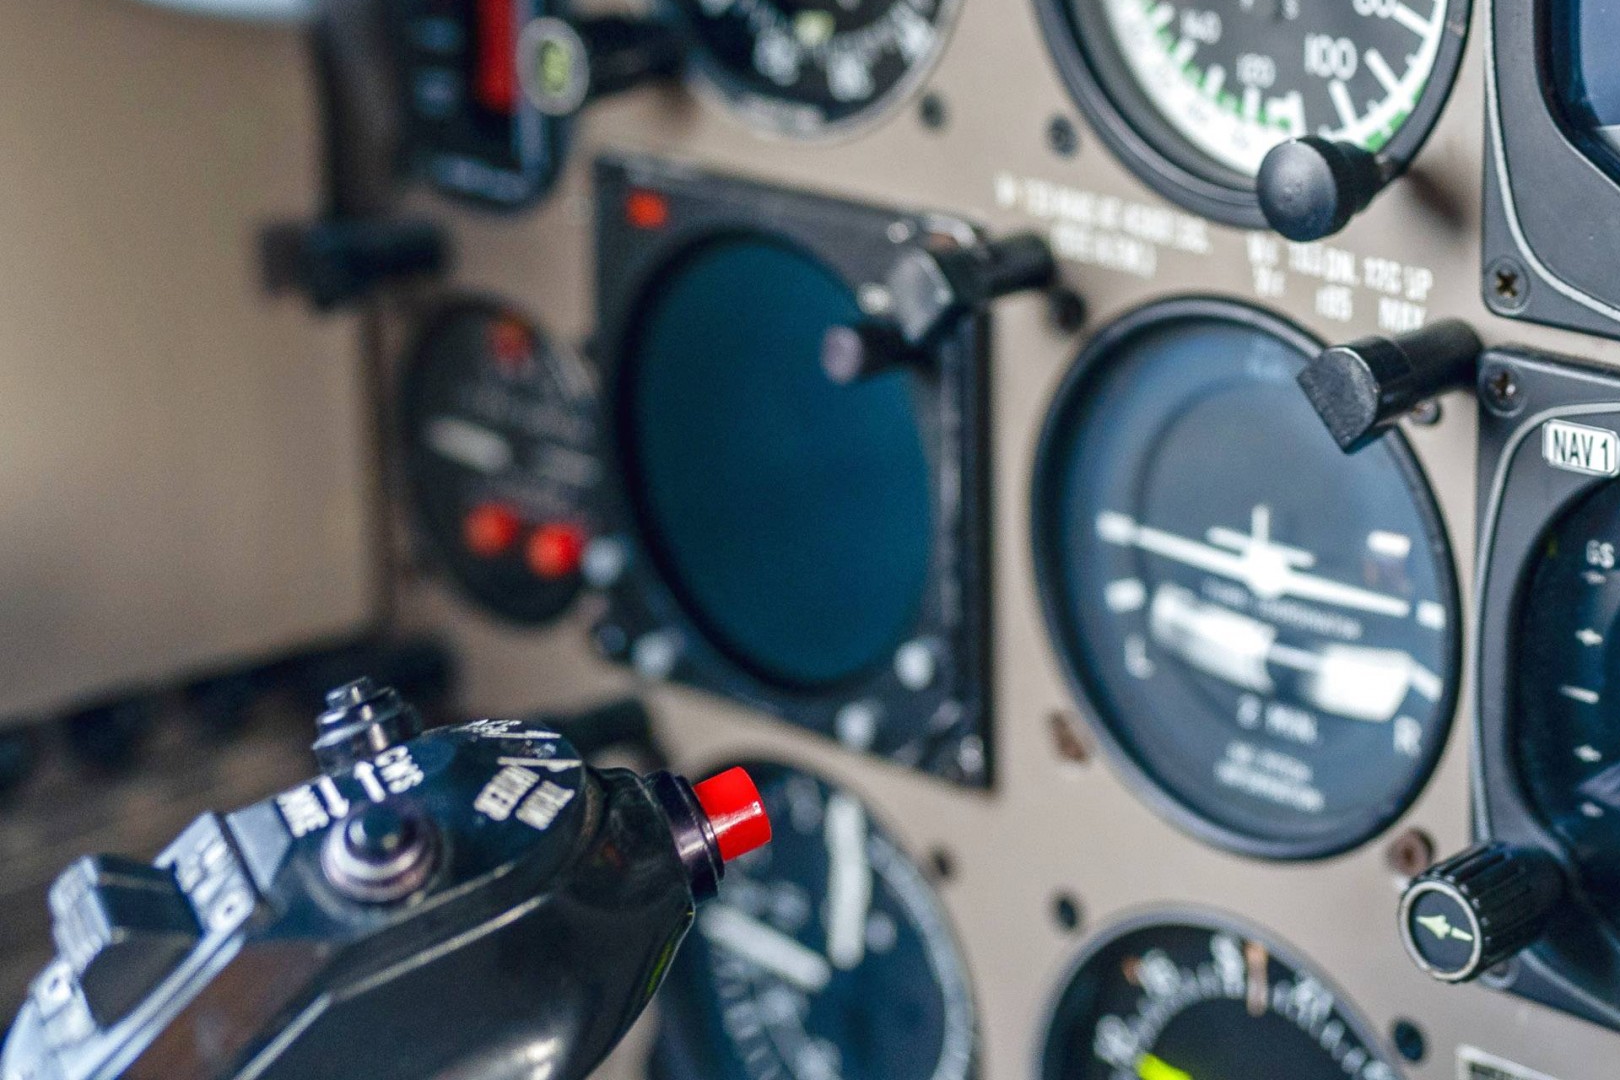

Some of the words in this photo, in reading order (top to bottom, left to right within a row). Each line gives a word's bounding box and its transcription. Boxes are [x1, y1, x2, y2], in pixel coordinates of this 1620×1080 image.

[1304, 34, 1358, 81] 100
[1553, 431, 1591, 465] NAV
[1599, 440, 1611, 470] 1
[1586, 541, 1614, 568] GS
